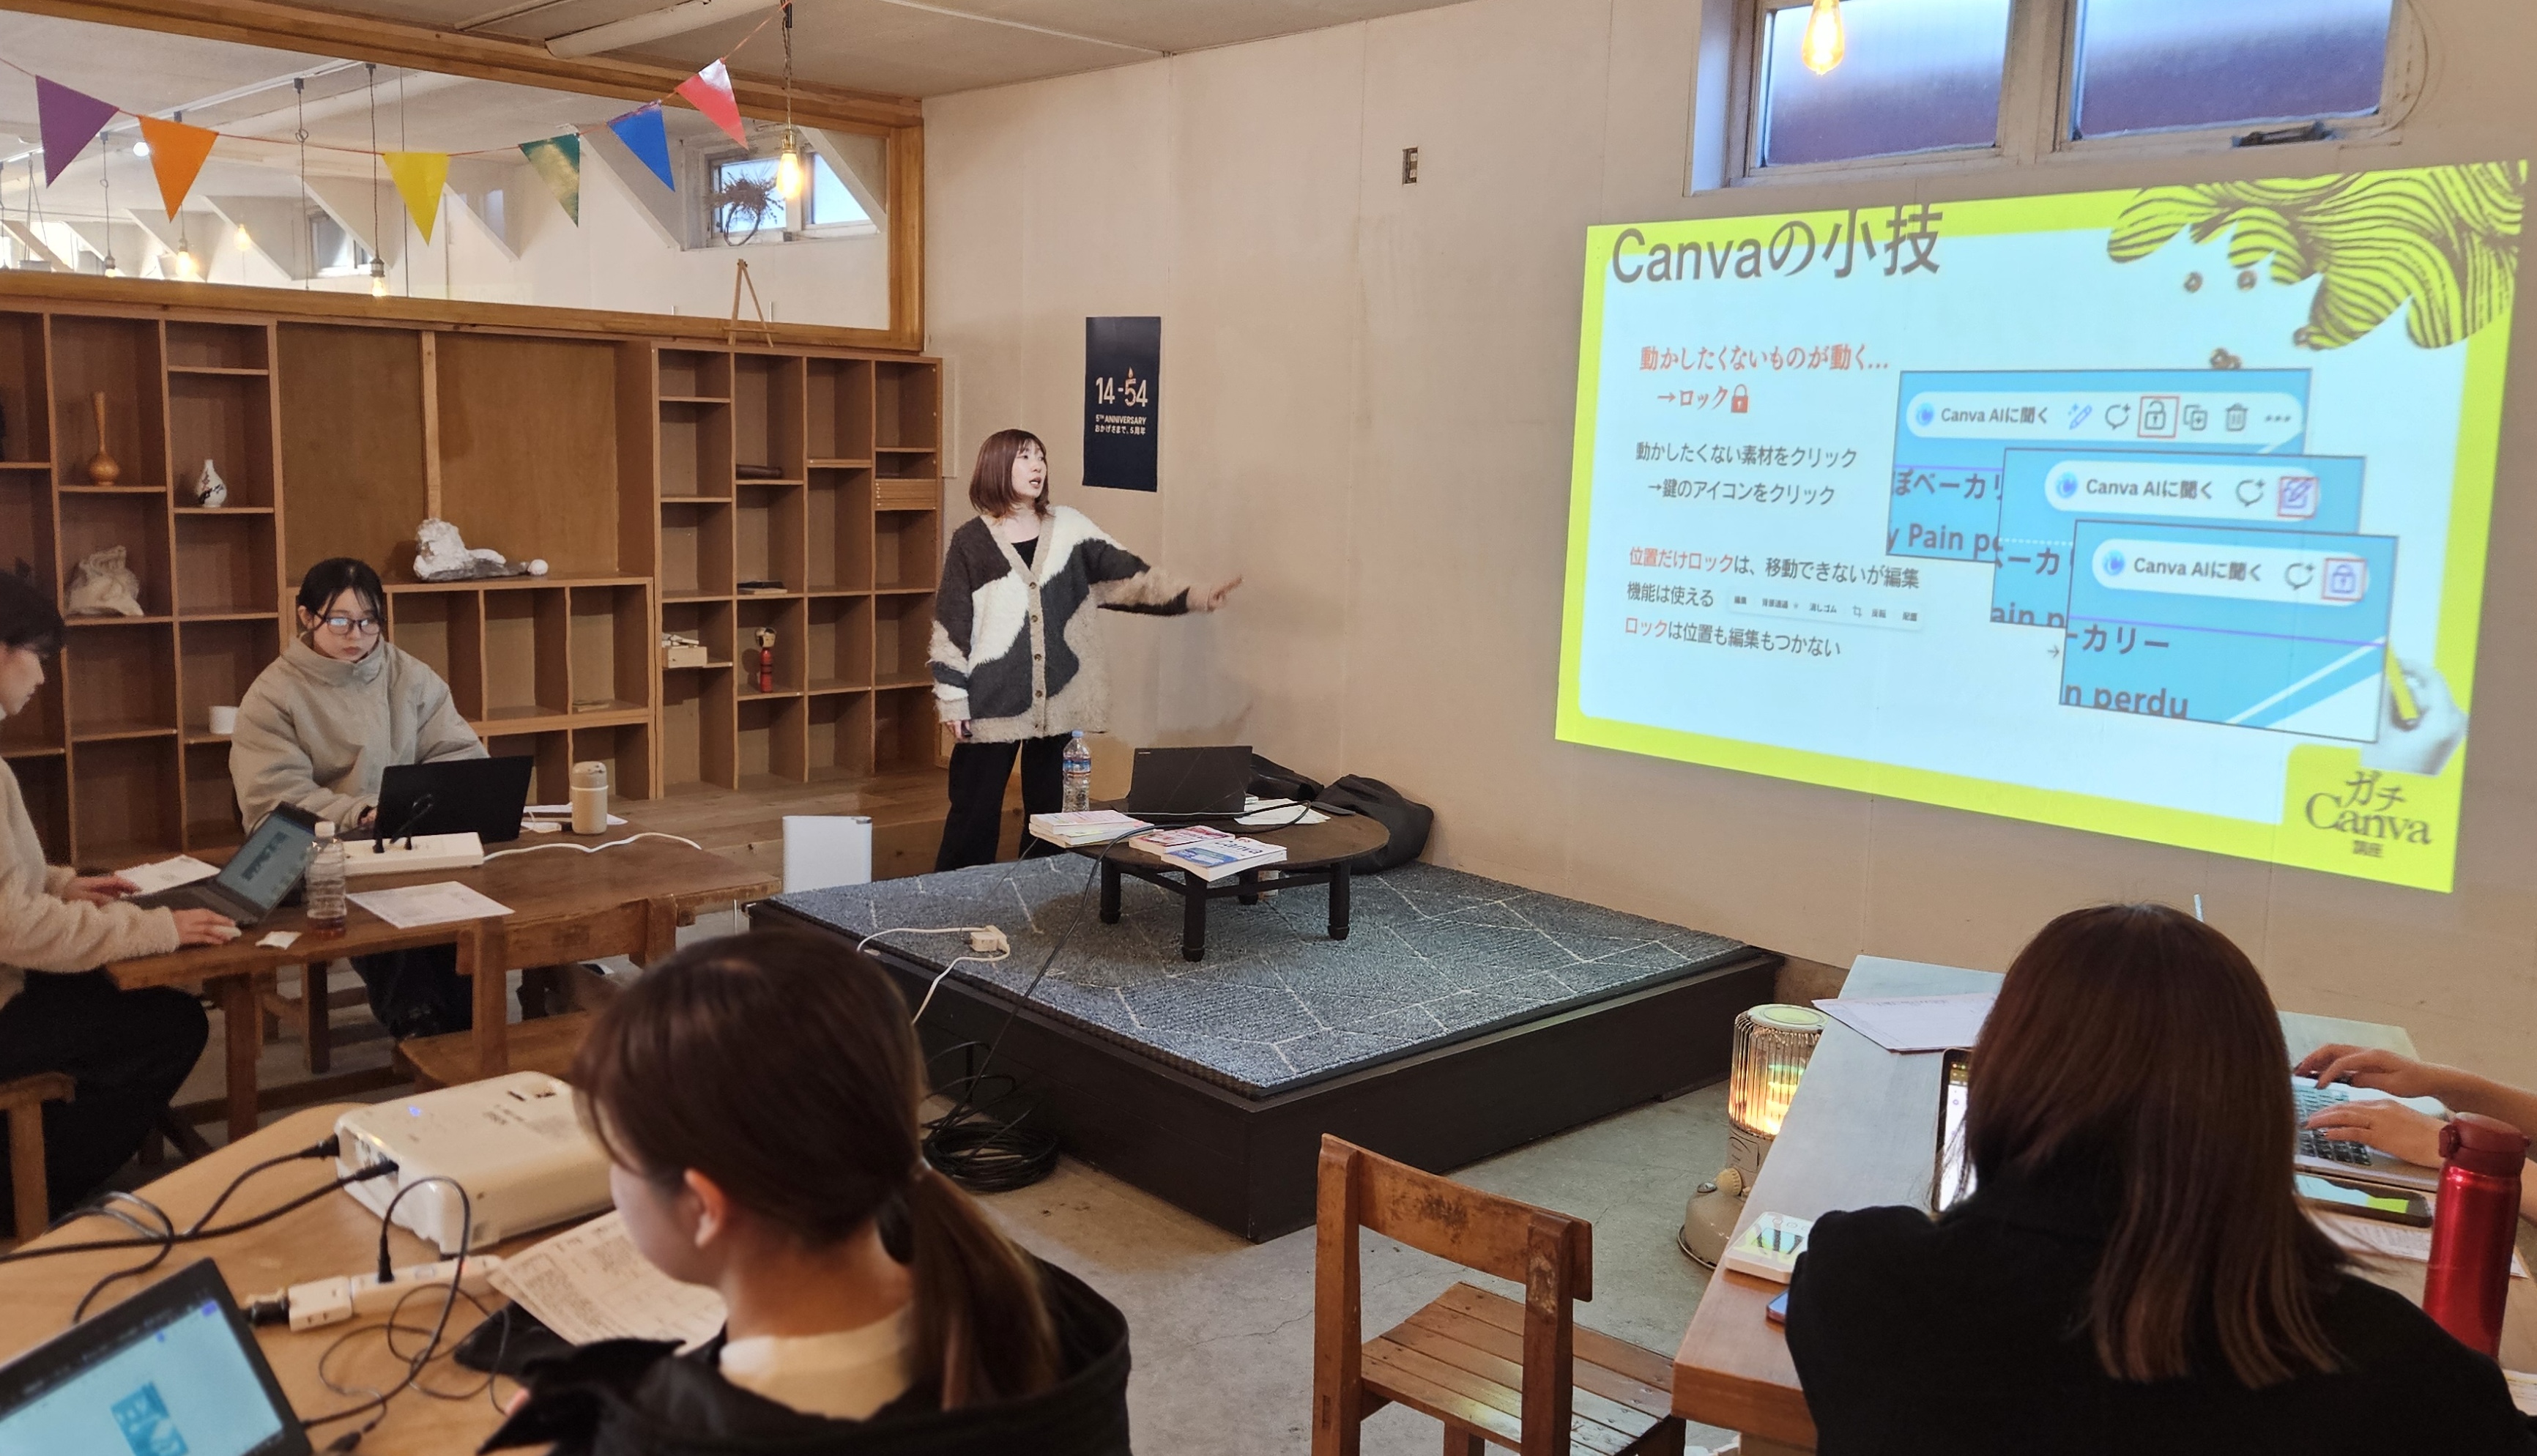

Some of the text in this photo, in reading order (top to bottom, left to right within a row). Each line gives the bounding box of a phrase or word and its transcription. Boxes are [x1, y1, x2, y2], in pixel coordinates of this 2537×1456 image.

[1612, 204, 1943, 283] Canvaの小技
[1096, 377, 1148, 407] 14-54
[1104, 415, 1147, 425] ANNIVERSARY
[1942, 406, 2048, 424] Canva AIに聞く
[1635, 441, 1857, 468] 動かしたくない素材をクリック
[2087, 479, 2213, 499] Canva AIに聞く
[1909, 523, 1964, 550] Pain
[1630, 546, 1920, 589] 位置だけロックは、移動できないが編集
[2134, 557, 2262, 582] Canva AIに聞く
[1627, 581, 1714, 607] 機能は使える
[1625, 617, 1840, 658] ロックは位置も編集もつかない
[2345, 770, 2406, 811] ガチ
[2306, 792, 2432, 844] Canva
